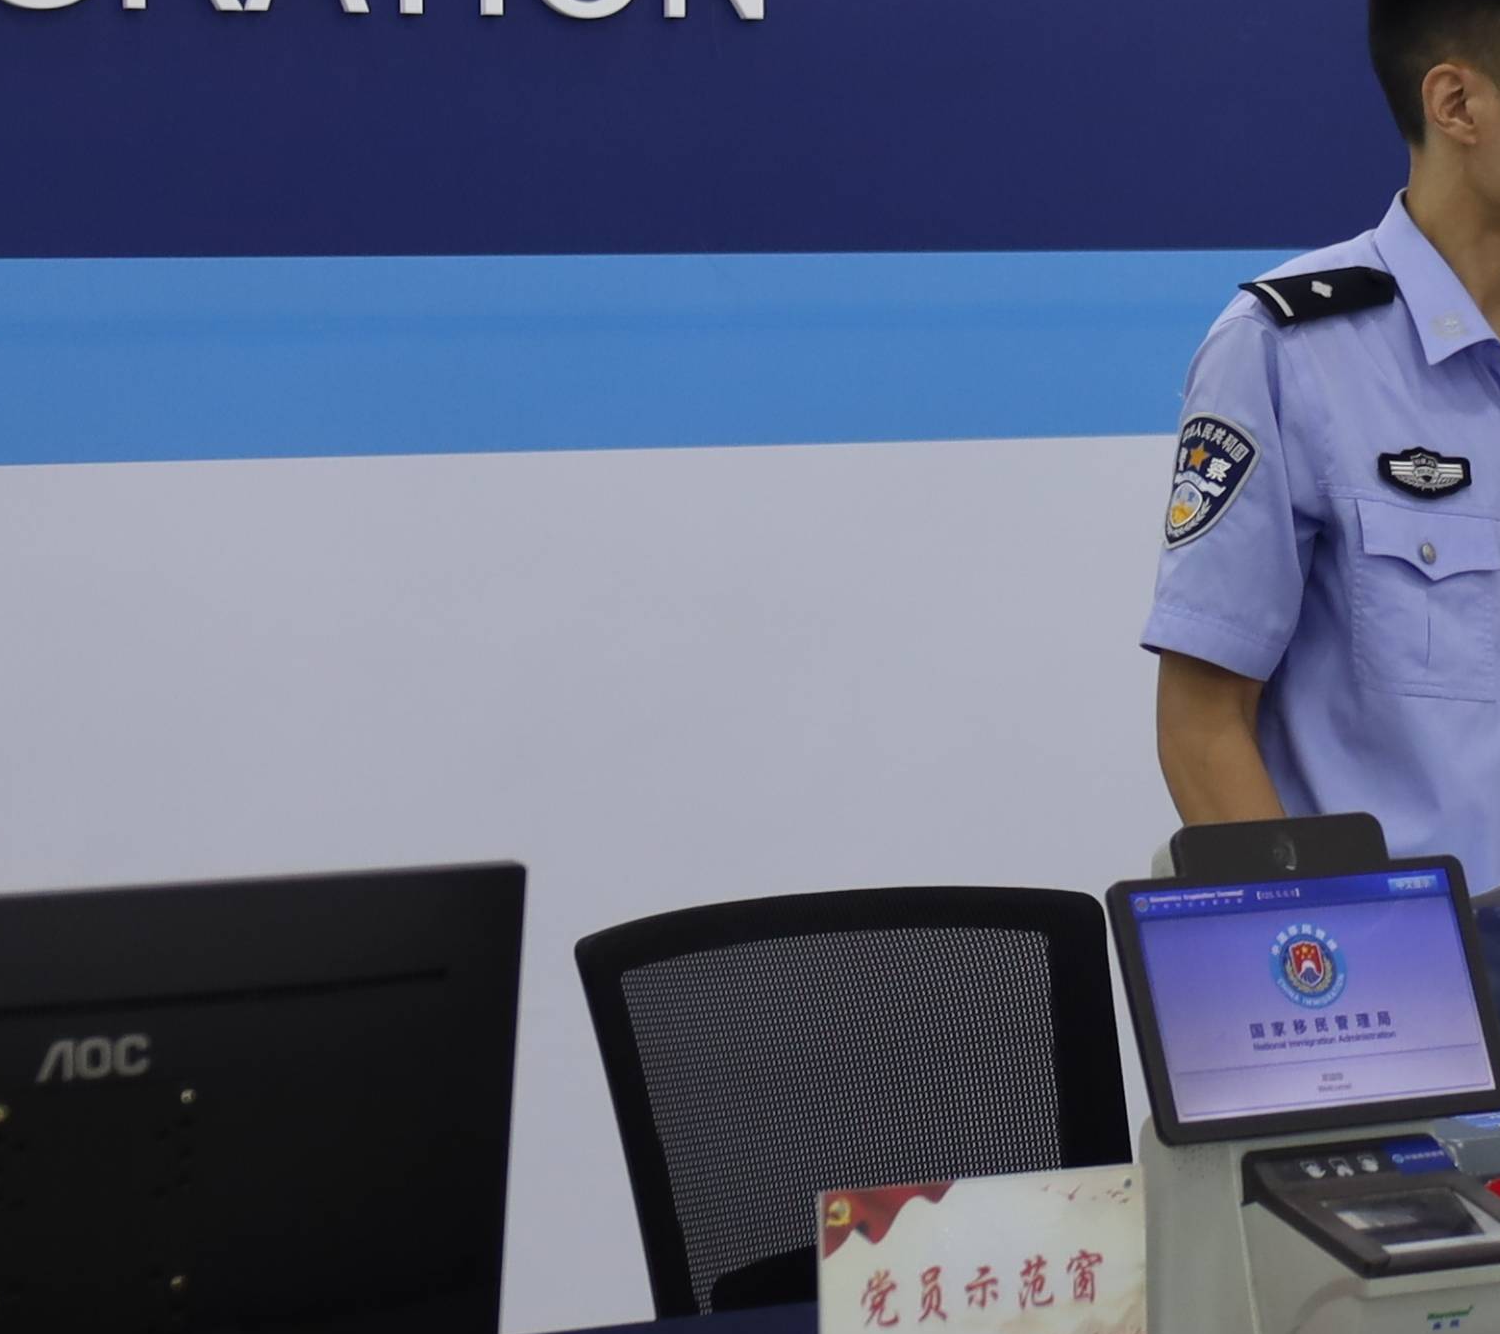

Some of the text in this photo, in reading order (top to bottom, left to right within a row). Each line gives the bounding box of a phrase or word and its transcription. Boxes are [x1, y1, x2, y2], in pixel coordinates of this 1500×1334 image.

[1250, 1011, 1391, 1039] 国家移民管理局
[35, 1033, 150, 1083] AOC
[861, 1249, 1104, 1328] 党员示范窗
